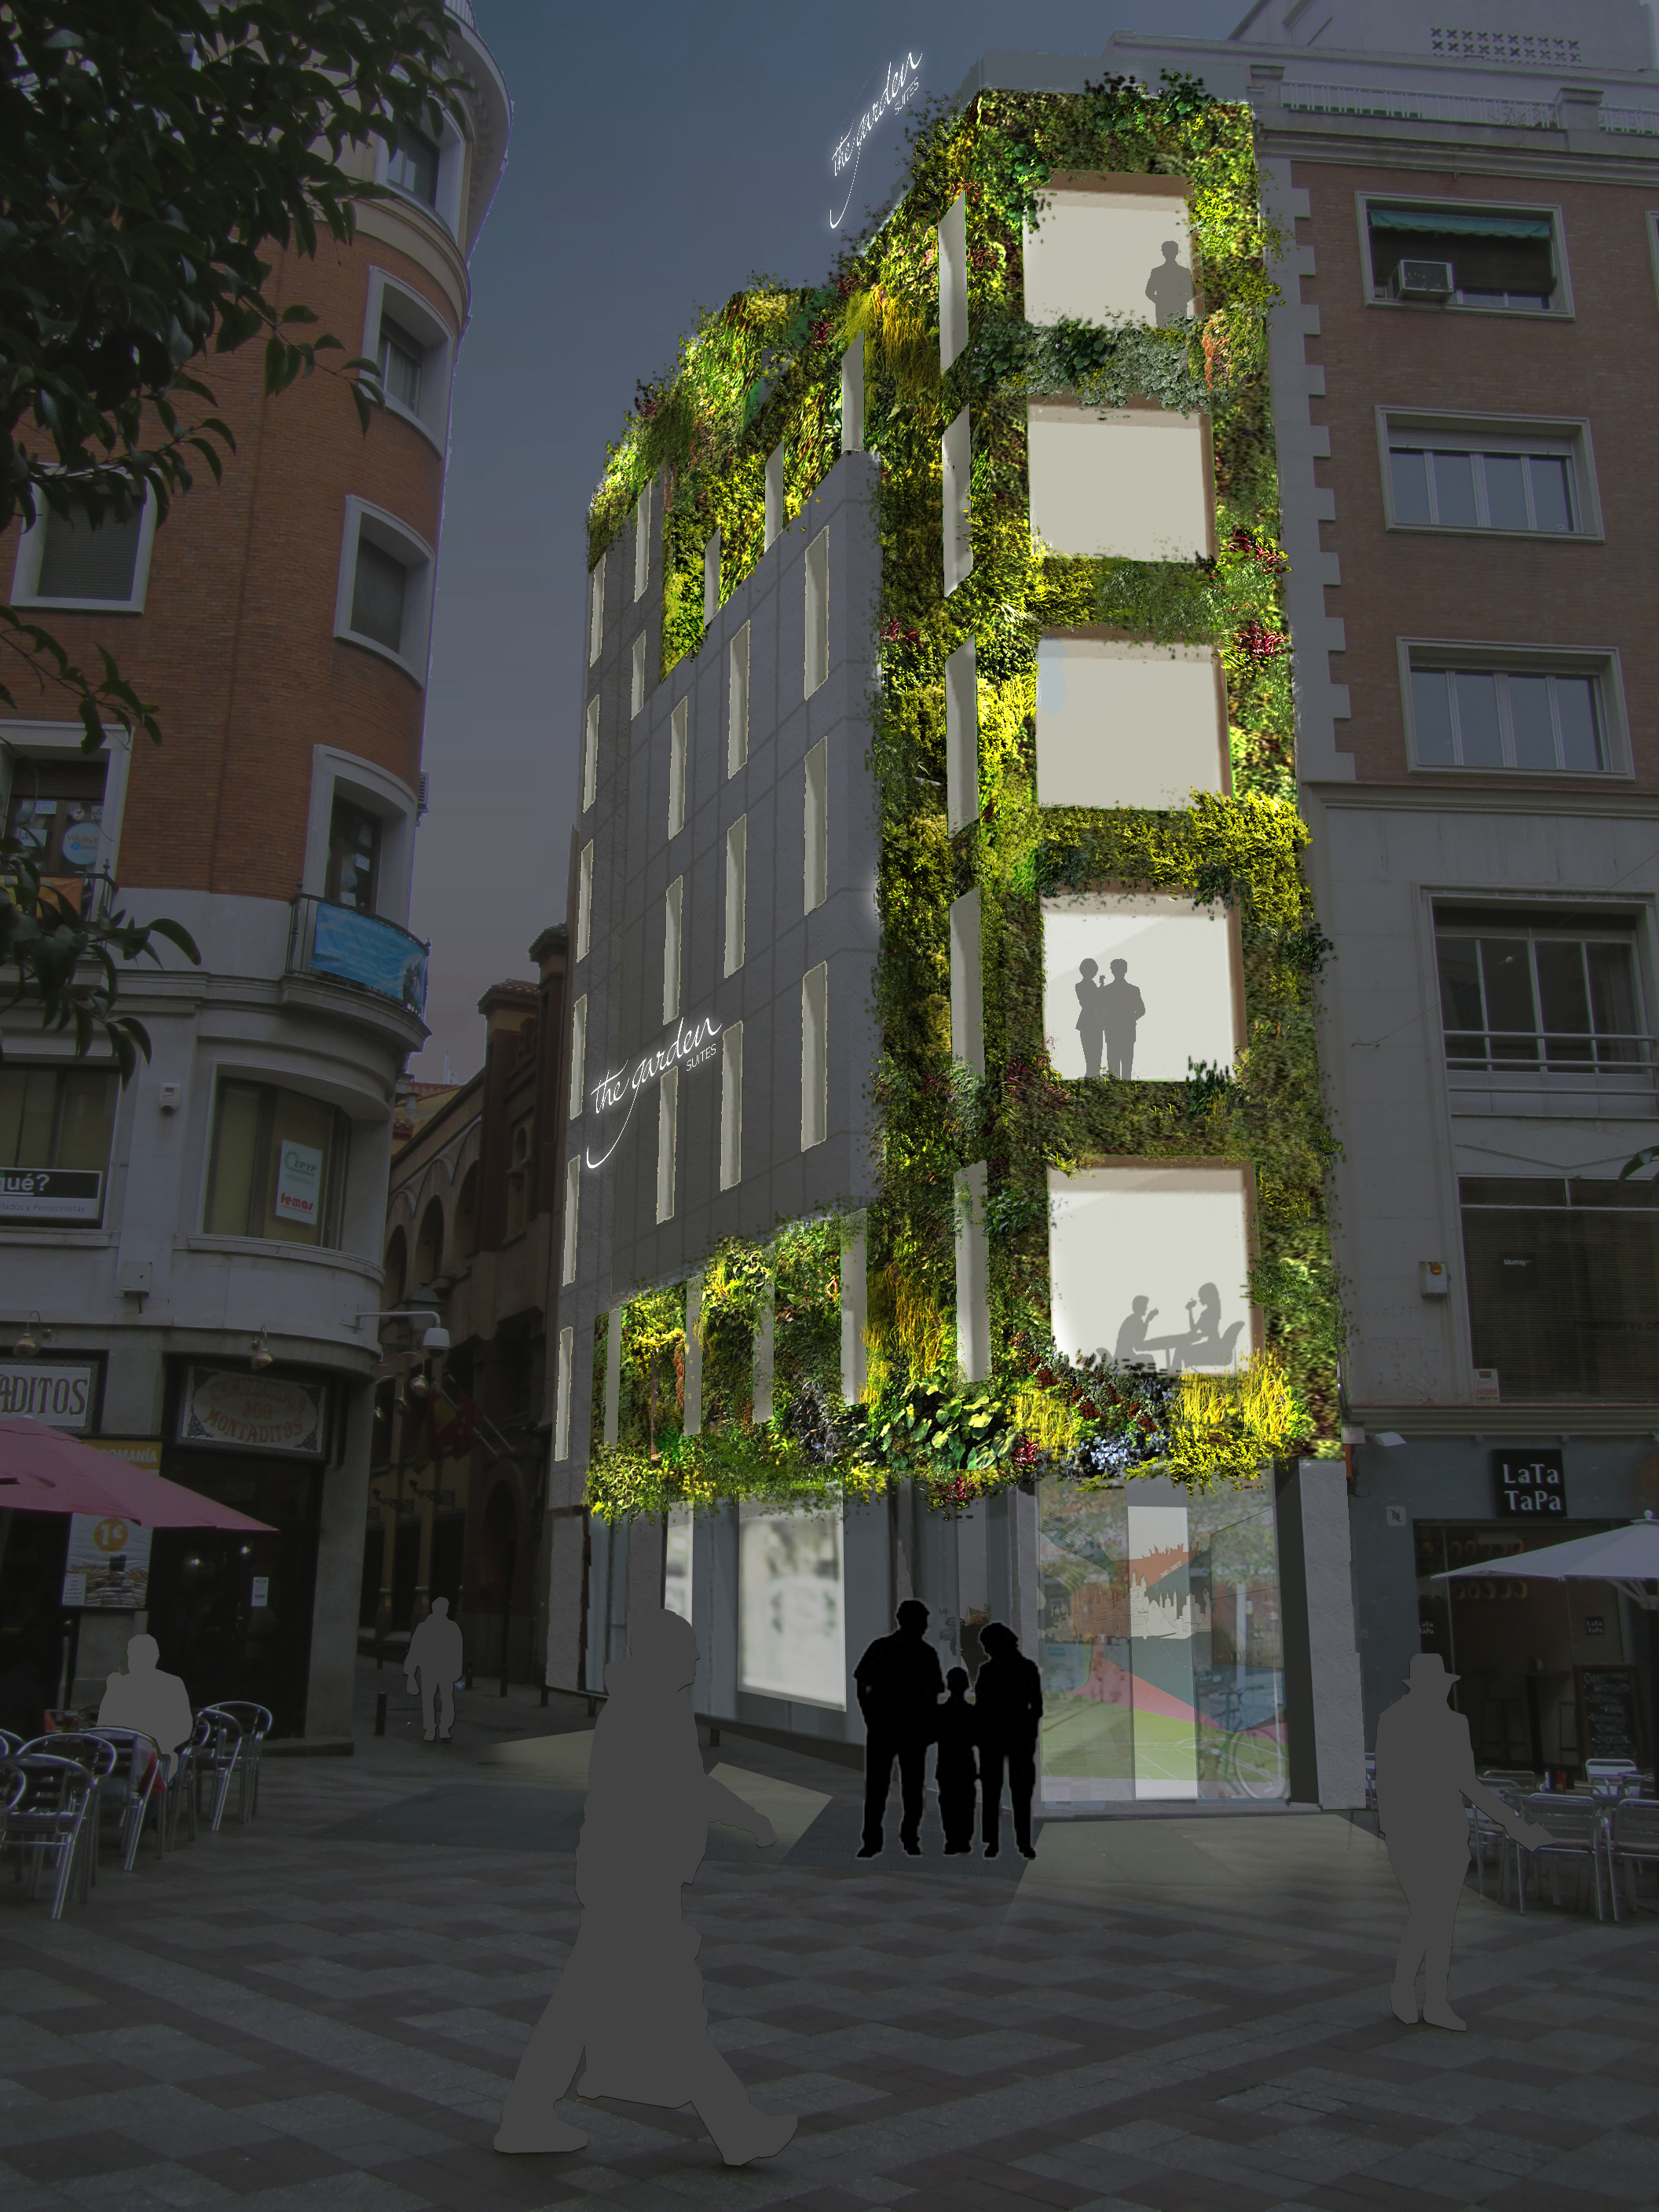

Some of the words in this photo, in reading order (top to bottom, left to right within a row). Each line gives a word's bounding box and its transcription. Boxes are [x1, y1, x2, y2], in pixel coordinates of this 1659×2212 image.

[895, 76, 919, 115] SUITES
[830, 52, 923, 229] garden
[832, 119, 855, 176] the
[686, 1043, 716, 1071] SUITES
[586, 1016, 723, 1169] garden
[591, 1058, 630, 1114] the
[33, 1203, 86, 1213] Pensionistas
[203, 1406, 303, 1444] MONTADITOS
[102, 1447, 157, 1463] OMANÍA
[1502, 1463, 1560, 1484] LaTa
[1504, 1489, 1562, 1511] TaPa
[101, 1523, 123, 1546] 1€
